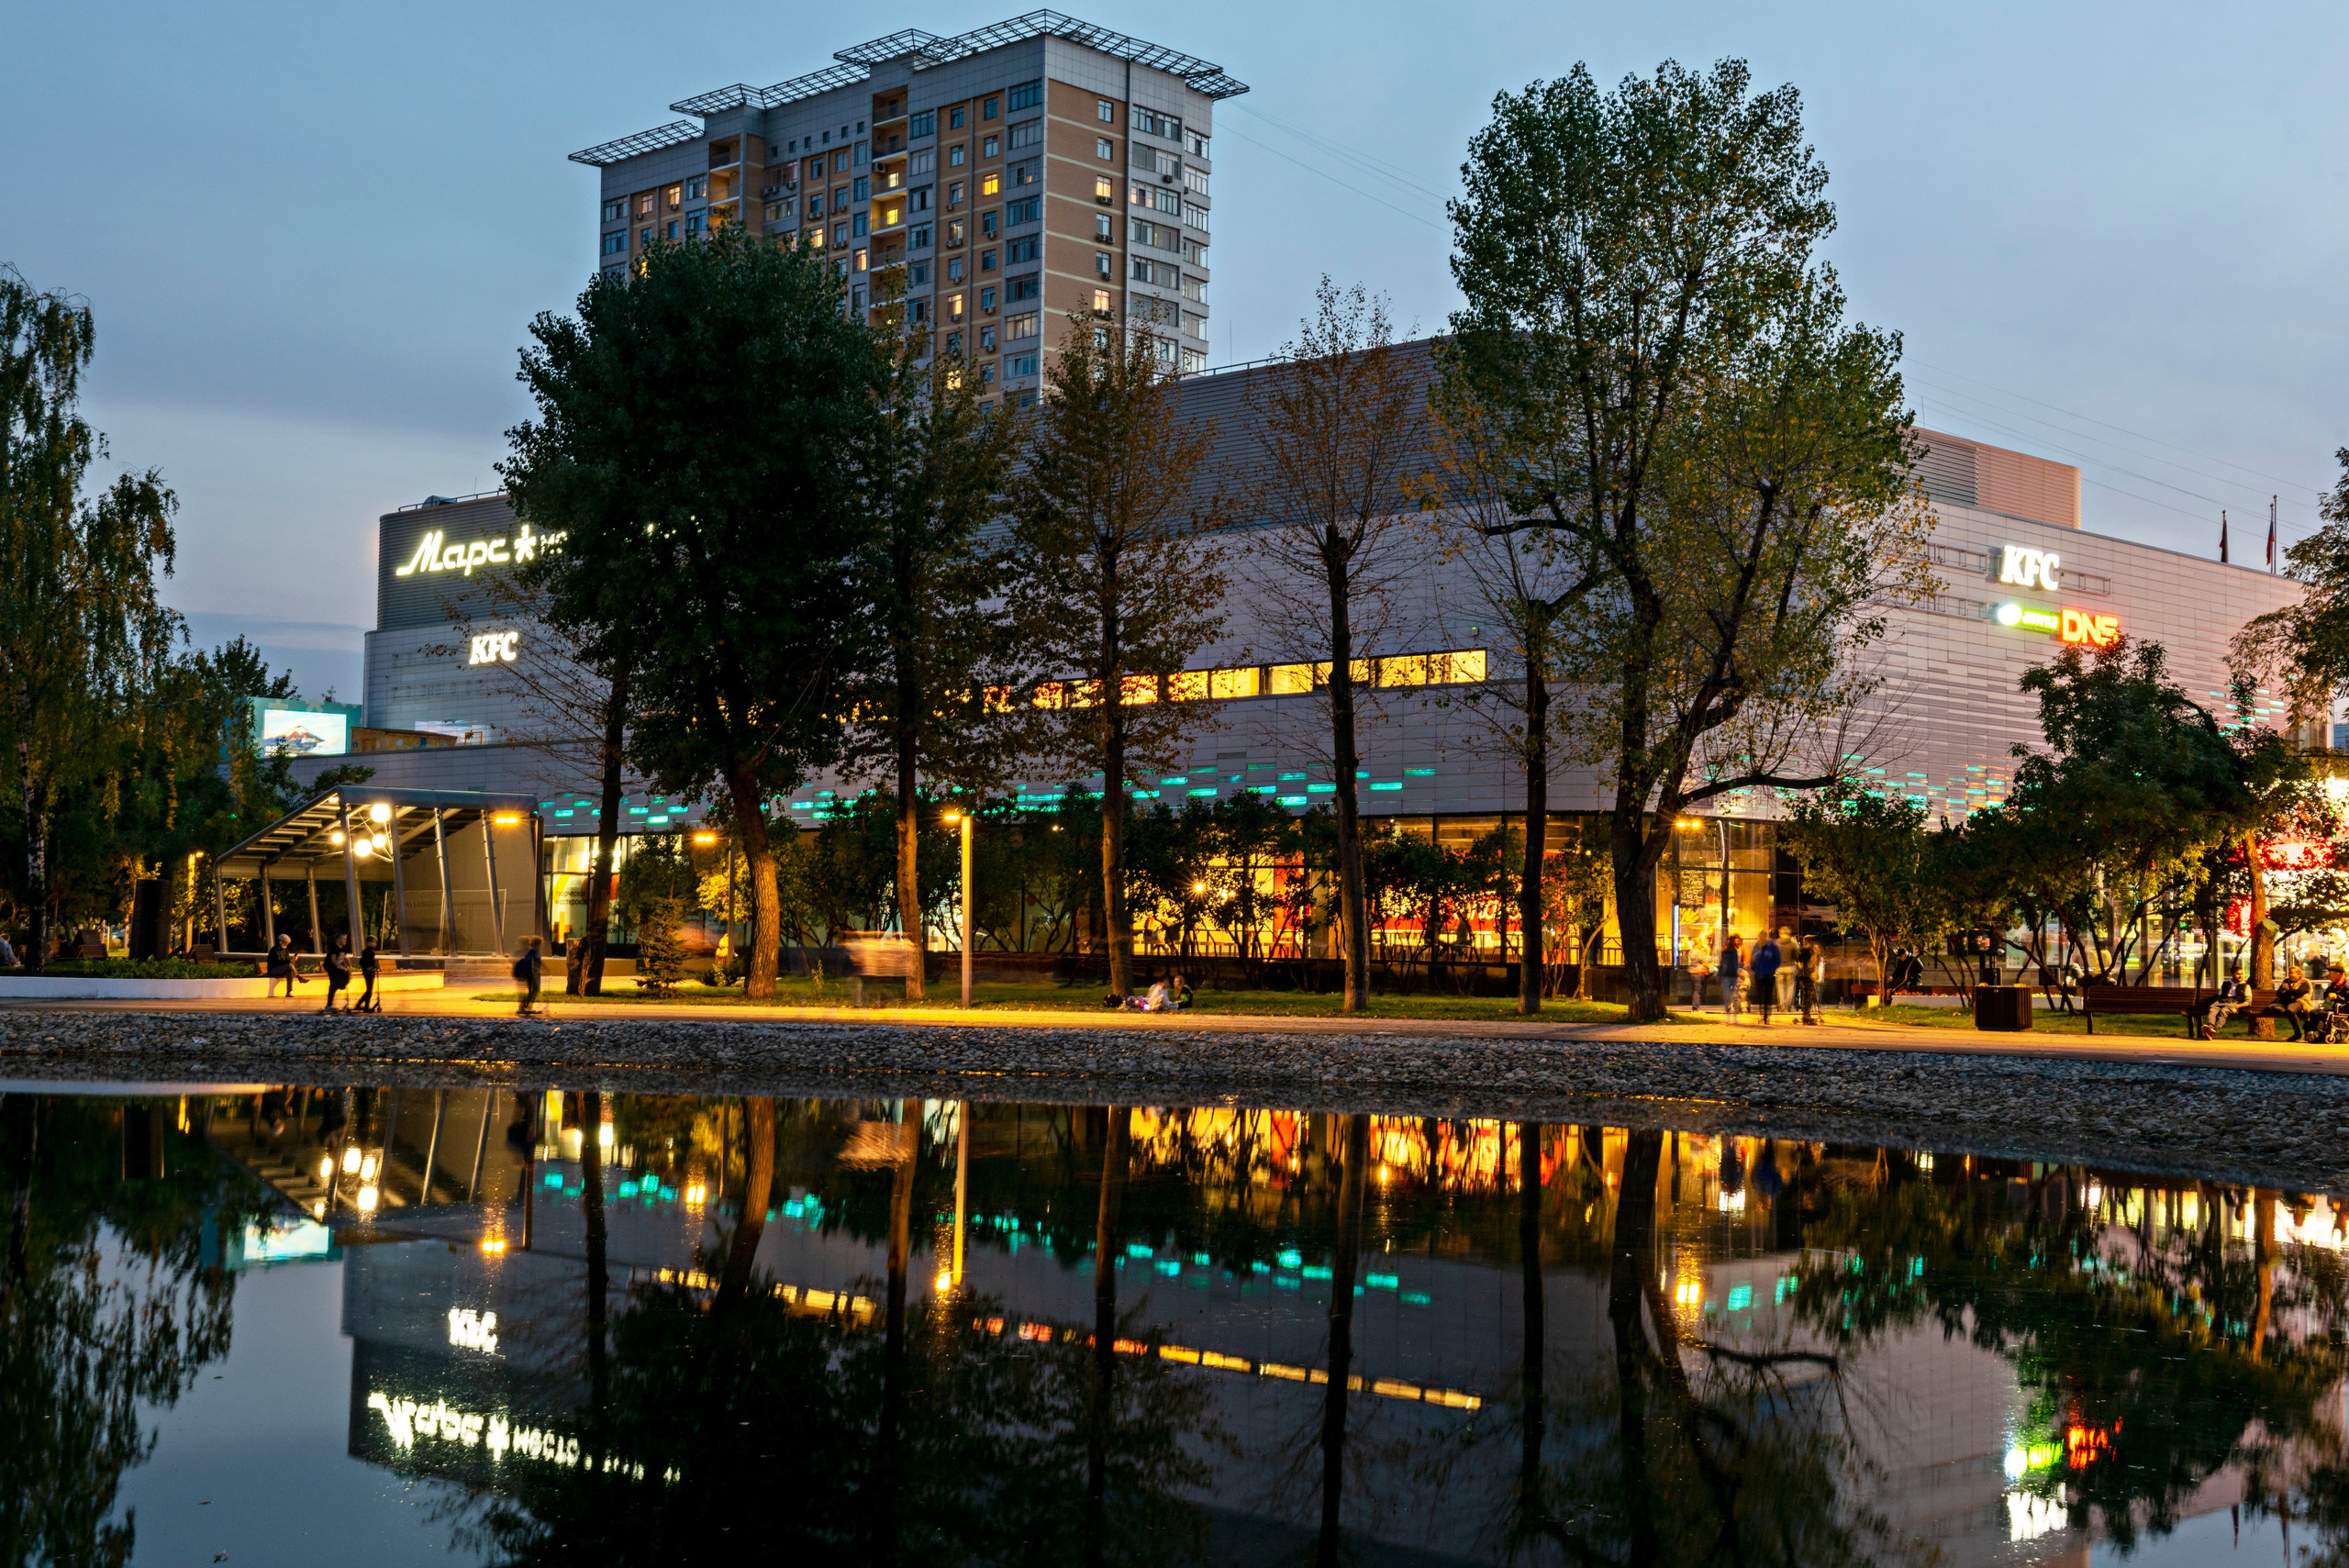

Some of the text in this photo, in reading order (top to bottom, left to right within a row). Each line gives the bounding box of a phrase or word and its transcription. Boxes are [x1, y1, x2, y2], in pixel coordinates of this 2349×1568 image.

[395, 530, 509, 576] Марс
[2000, 544, 2059, 591] KFC
[469, 631, 518, 665] KFC
[2062, 608, 2119, 646] DNS
